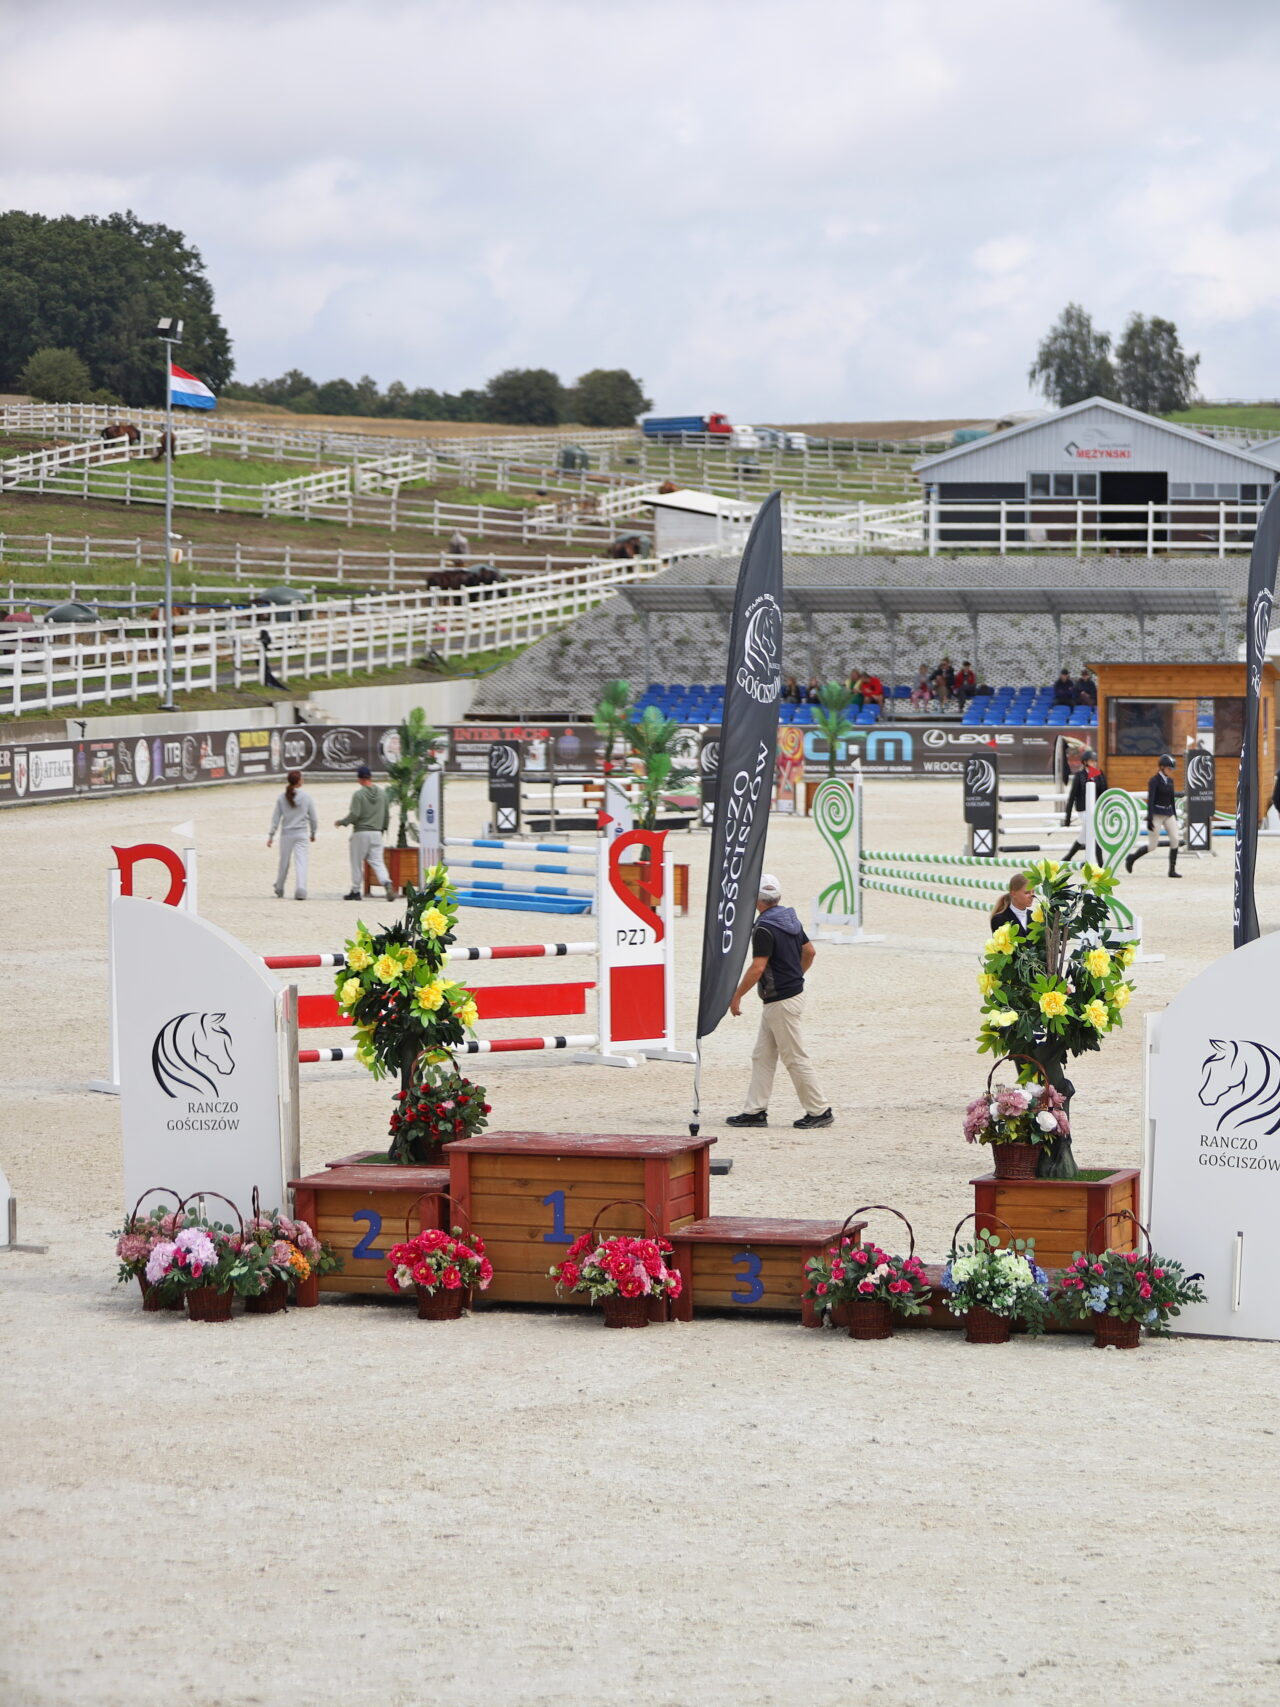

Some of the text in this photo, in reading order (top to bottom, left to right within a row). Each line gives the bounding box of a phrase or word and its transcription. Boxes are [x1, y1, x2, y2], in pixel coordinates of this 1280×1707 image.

[453, 728, 499, 741] INTER
[948, 733, 1015, 745] LEXUS
[923, 761, 964, 772] WROCŁ
[617, 929, 647, 946] PZJ
[188, 1101, 239, 1114] RANCZO
[166, 1116, 240, 1131] GOŚCISZÓW
[1199, 1134, 1258, 1151] RANCZO
[542, 1189, 575, 1244] 1
[352, 1208, 385, 1260] 2
[731, 1252, 764, 1304] 3
